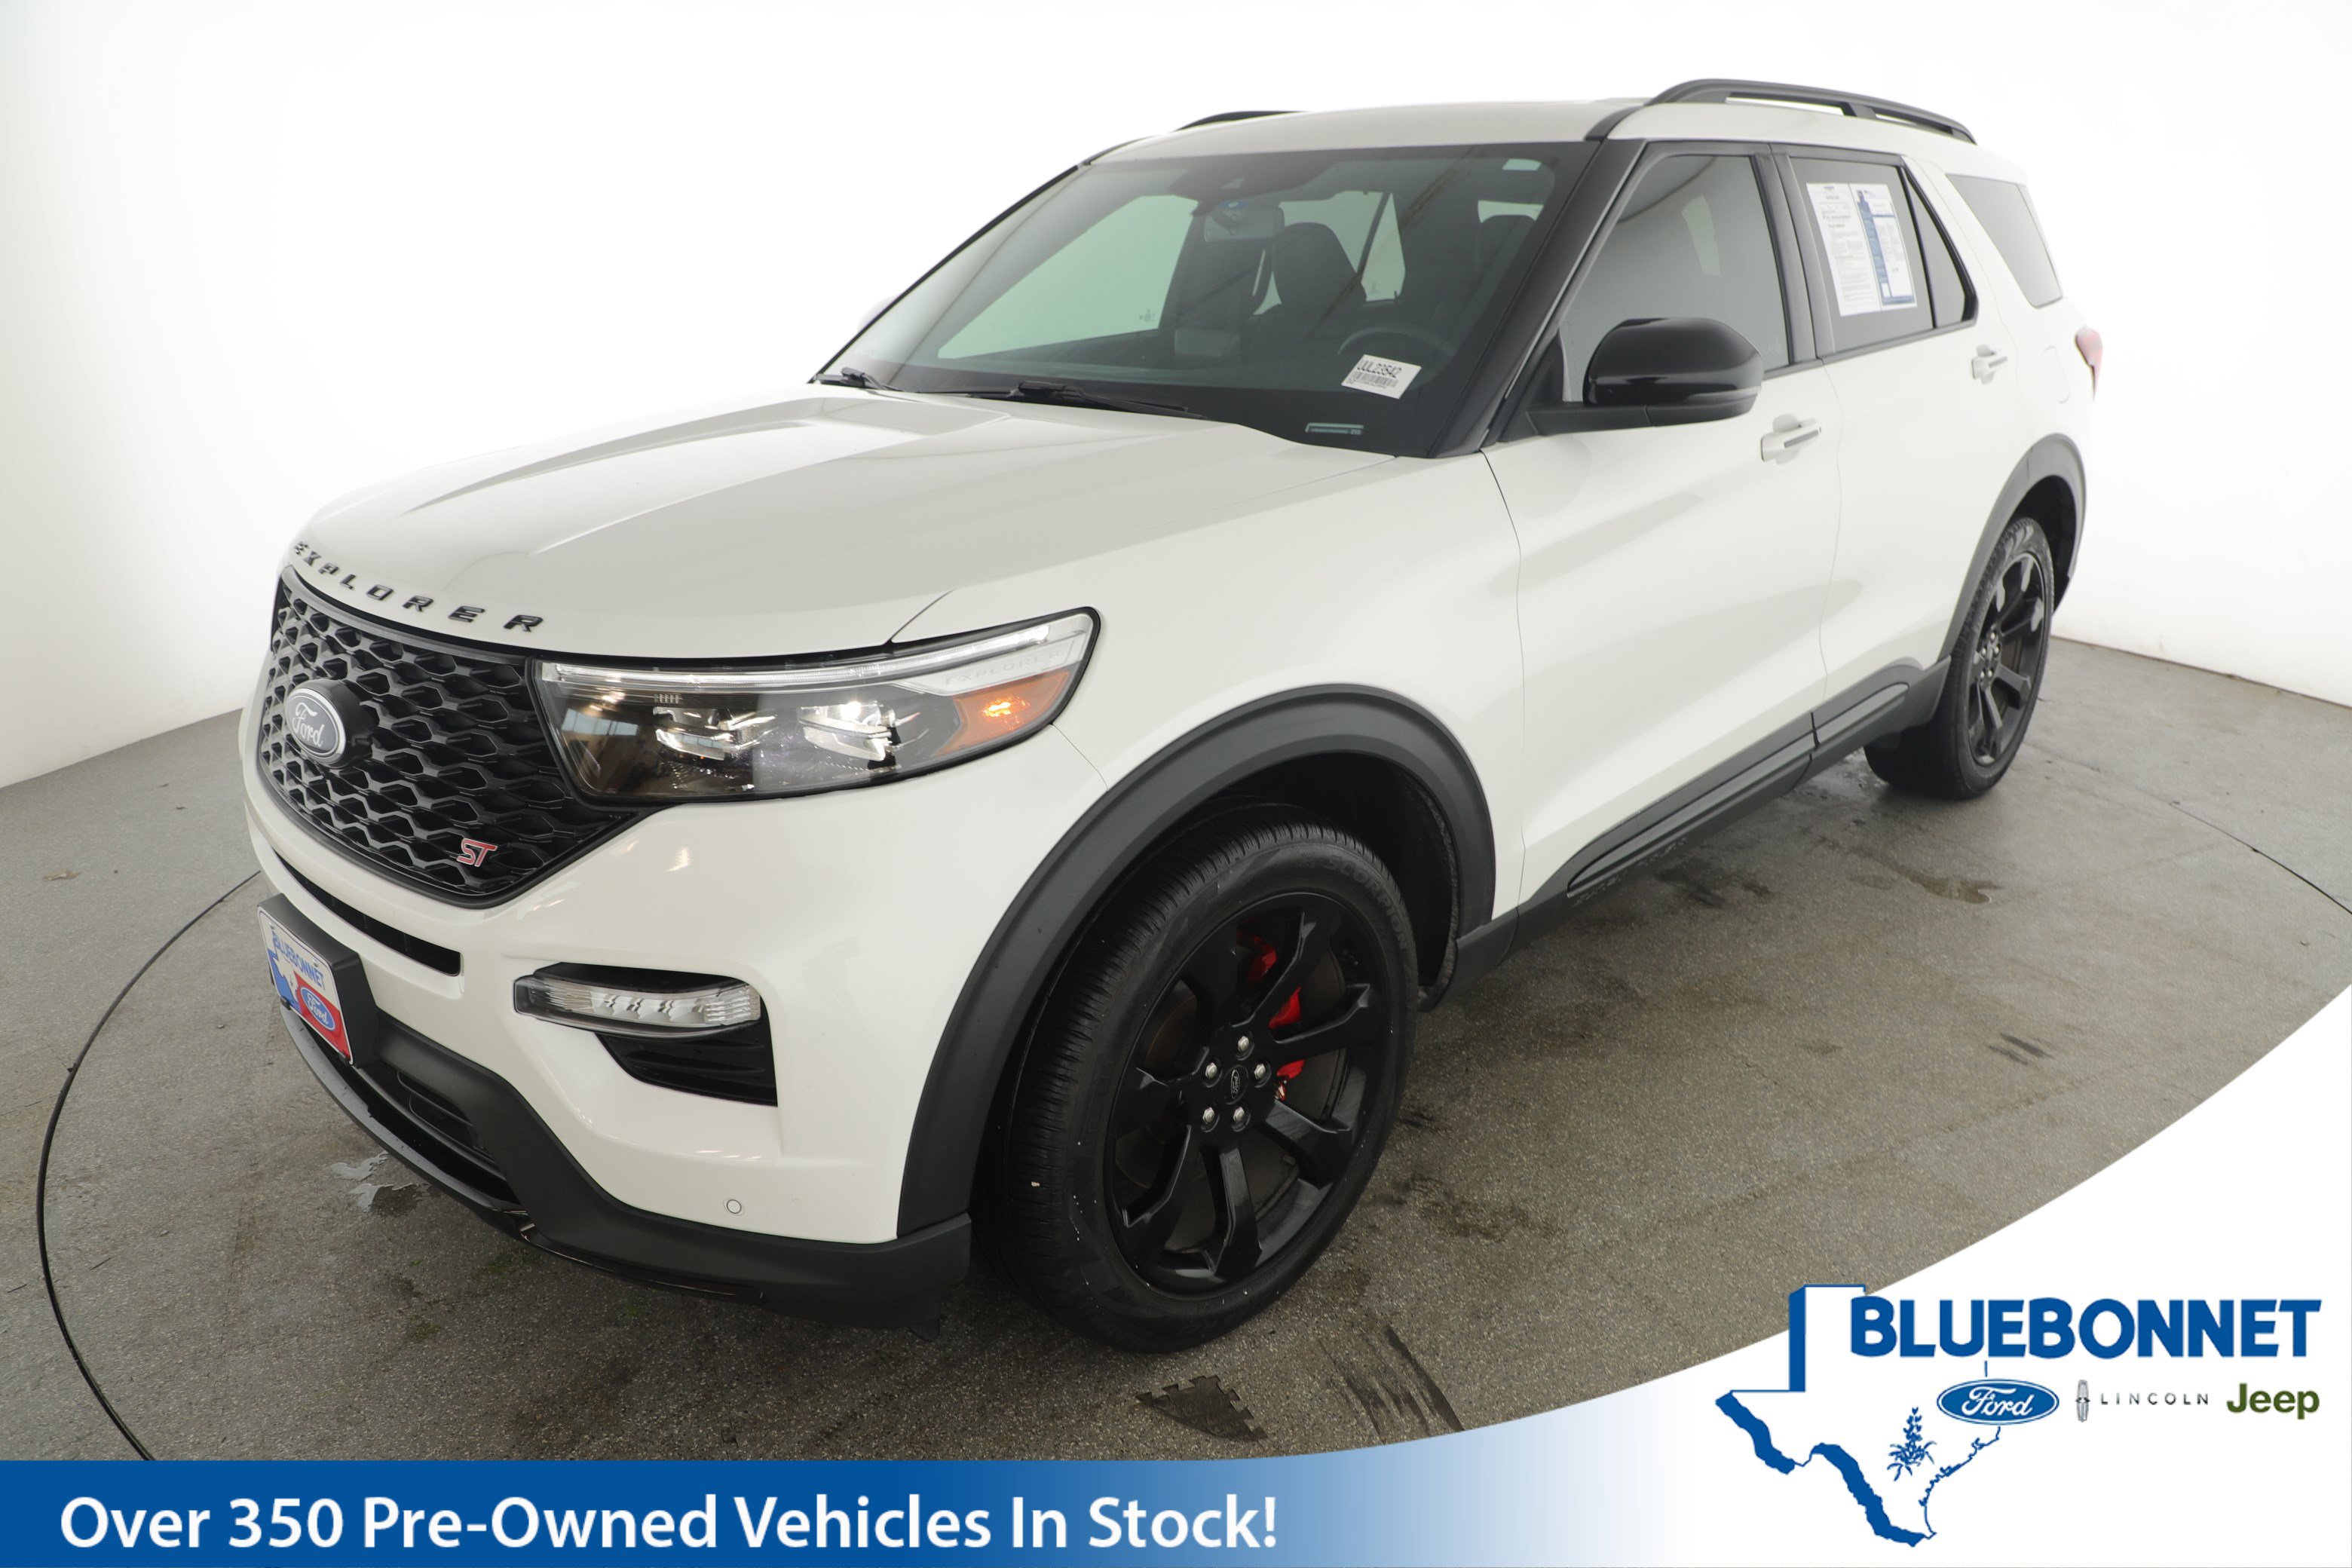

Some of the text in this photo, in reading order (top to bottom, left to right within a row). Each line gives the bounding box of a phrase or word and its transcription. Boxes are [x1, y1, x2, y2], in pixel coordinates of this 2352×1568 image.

[293, 541, 544, 632] EXPLORER
[945, 651, 1063, 685] EXPLORER
[292, 702, 325, 748] Ford
[456, 838, 498, 868] ST
[1324, 855, 1407, 950] SCORPION
[271, 930, 326, 991] BLUEBONNET
[307, 991, 329, 1025] Ford
